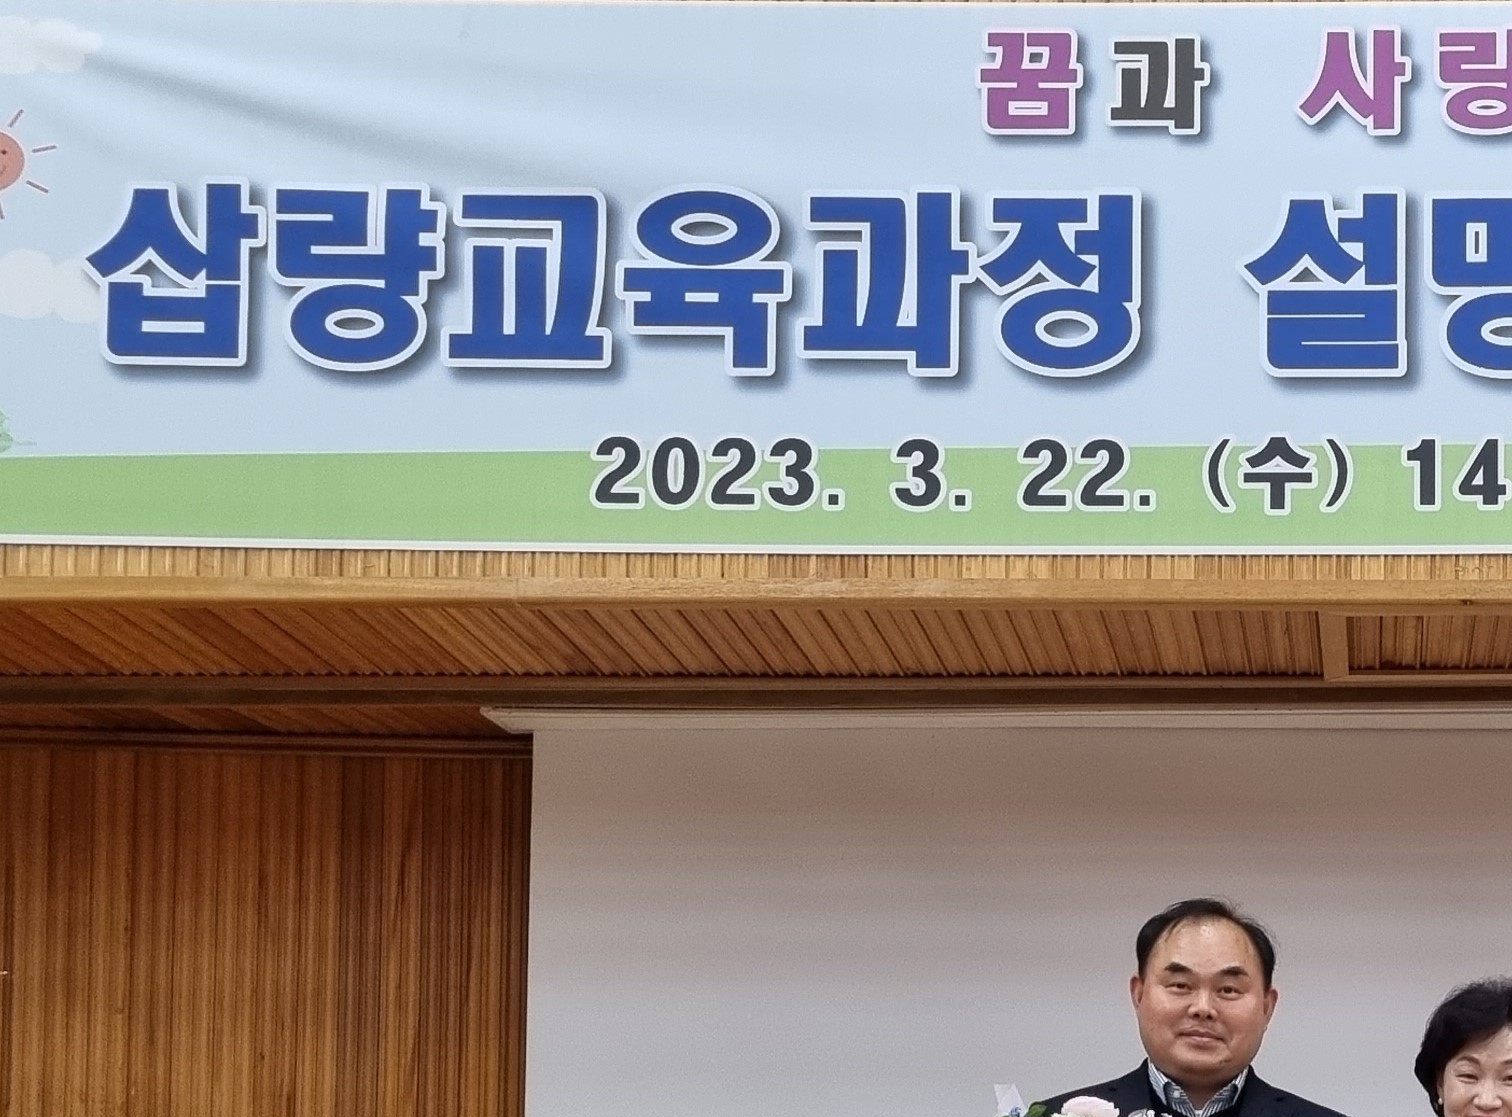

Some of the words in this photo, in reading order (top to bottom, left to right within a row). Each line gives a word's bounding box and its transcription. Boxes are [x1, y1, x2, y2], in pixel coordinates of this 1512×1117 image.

[979, 33, 1203, 129] 꿈과
[86, 183, 1134, 370] 삽량교육과정
[596, 436, 839, 506] 2023.
[894, 438, 967, 506] 3.
[1021, 438, 1151, 506] 22.
[1207, 436, 1348, 509] (수)
